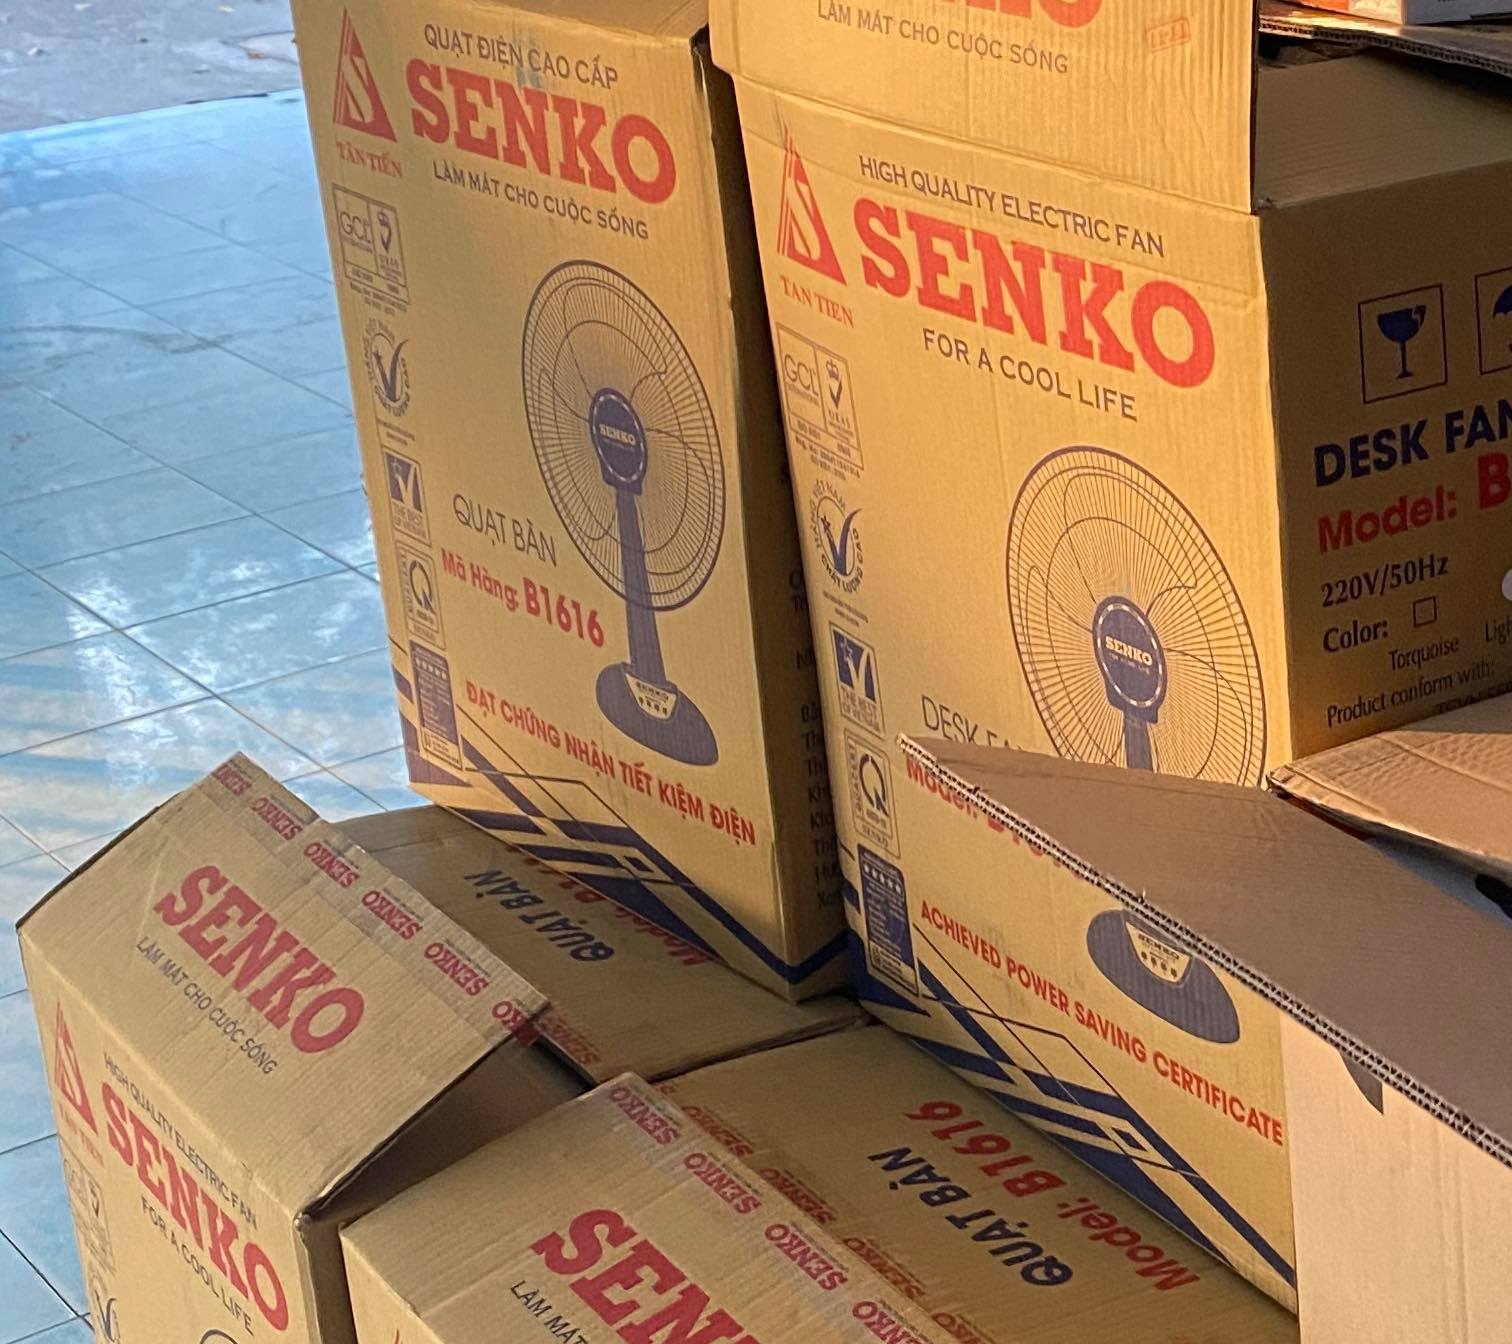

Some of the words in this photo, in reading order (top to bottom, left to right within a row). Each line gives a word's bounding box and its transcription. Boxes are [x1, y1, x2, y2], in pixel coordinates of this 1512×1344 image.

[425, 24, 474, 56] QUẠT
[478, 37, 524, 68] ĐIỆN
[528, 48, 571, 79] CAO
[575, 54, 618, 90] CẤP
[817, 0, 852, 27] LÀM
[856, 7, 892, 35] MÁT
[899, 18, 940, 45] CHO
[946, 28, 1003, 60] CUỘC
[1009, 40, 1068, 75] SỐNG
[406, 59, 676, 204] SENKO
[433, 159, 467, 190] LÀM
[470, 172, 501, 198] MÁT
[505, 184, 539, 210] CHO
[544, 195, 592, 224] CUỘC
[597, 208, 649, 239] SỐNG
[859, 154, 908, 187] HIGH
[910, 165, 996, 212] QUALITY
[1000, 195, 1110, 243] ELECTRIC
[1115, 223, 1163, 257] FAN
[852, 197, 1215, 387] SENKO
[922, 328, 970, 366] FOR
[978, 347, 995, 373] A
[999, 356, 1067, 399] COOL
[1078, 381, 1136, 417] LIFE
[1314, 420, 1428, 487] DESK
[451, 492, 509, 547] QUẠT
[510, 514, 557, 567] BÀN
[1318, 486, 1457, 553] Model:
[440, 548, 467, 583] Mã
[472, 562, 519, 613] Hàng:
[522, 577, 605, 648] B1616
[1322, 553, 1448, 607] 220V/50Hz
[1105, 635, 1152, 666] SENKO
[1323, 620, 1388, 653] Color:
[1389, 635, 1459, 671] Torquoise
[1327, 689, 1385, 727] Product
[1390, 671, 1453, 703] conform
[1457, 659, 1494, 692] with:
[465, 680, 496, 724] ĐẠT
[500, 696, 560, 753] CHỨNG
[564, 726, 616, 778] NHẬN
[618, 750, 653, 798] TIẾT
[656, 776, 705, 823] KIỆM
[707, 796, 756, 847] ĐIỆN
[154, 865, 365, 1054] SENKO
[424, 941, 488, 996] SENKO
[921, 900, 1001, 971] ACHIEVED
[1006, 955, 1071, 1018] POWER
[1074, 999, 1147, 1062] SAVING
[1152, 1048, 1283, 1147] CERTIFICATE
[868, 1144, 974, 1209] BÀN
[907, 1099, 1067, 1198] B1616
[102, 1082, 289, 1332] SENKO
[1058, 1193, 1201, 1291] Model:
[950, 1210, 1074, 1287] QUẠT
[510, 1280, 549, 1320] LÀM
